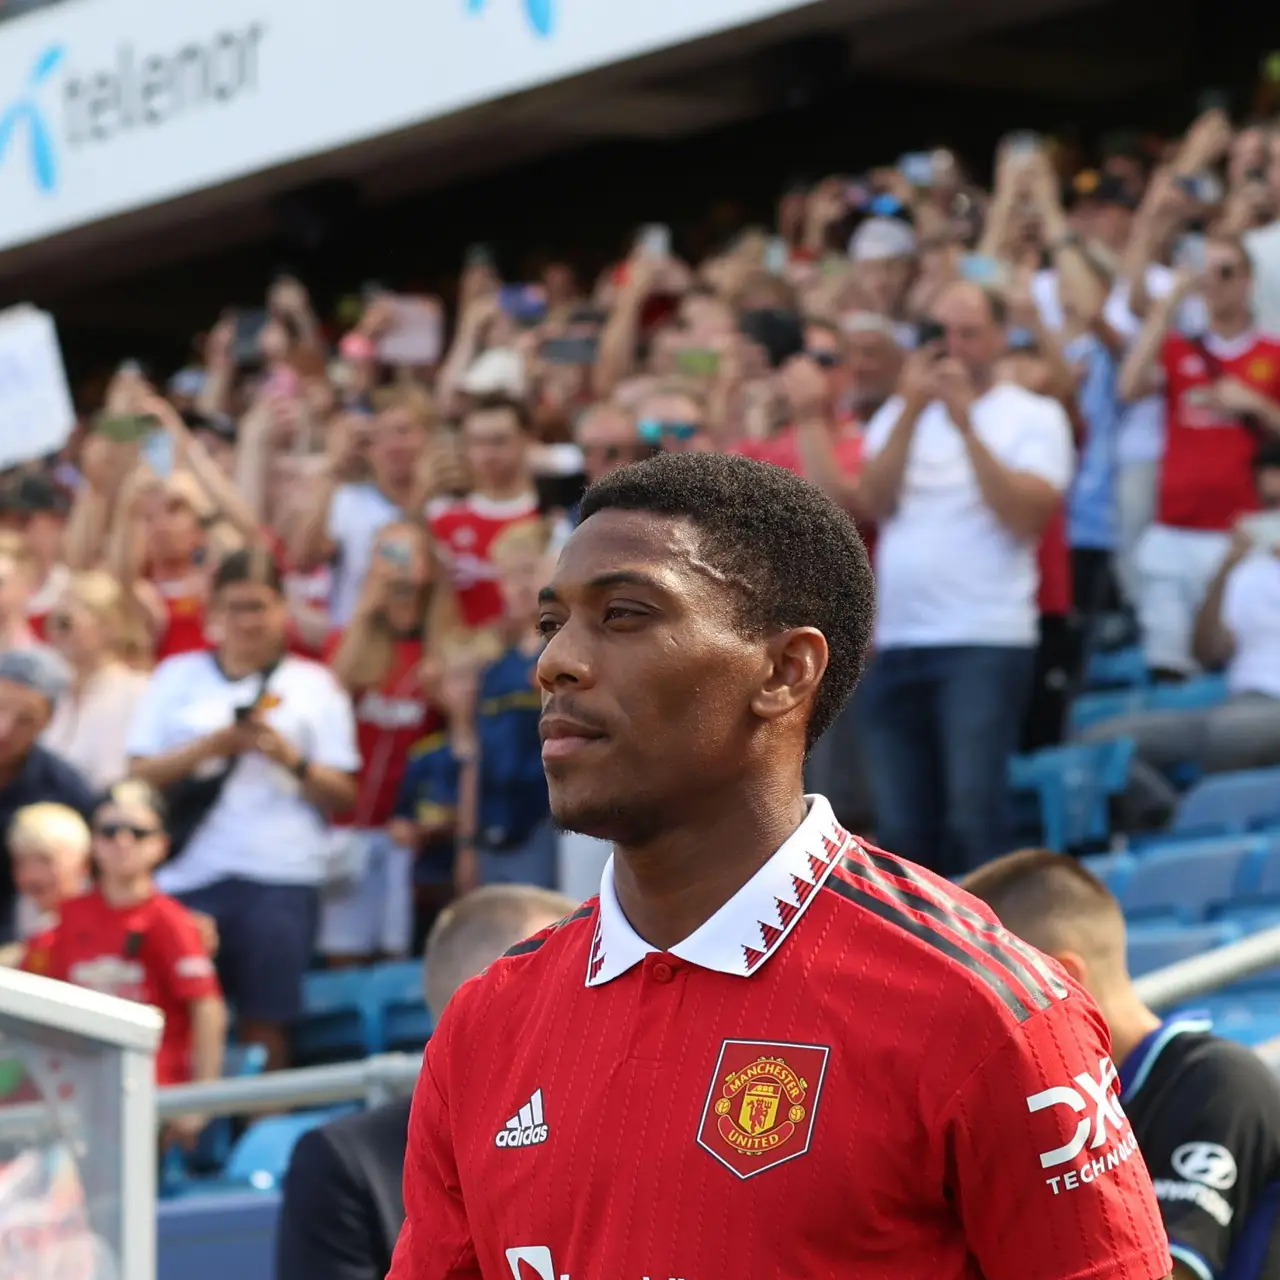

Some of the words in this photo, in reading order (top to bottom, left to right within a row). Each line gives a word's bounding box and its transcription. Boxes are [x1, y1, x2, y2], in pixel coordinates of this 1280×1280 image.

[62, 21, 267, 146] telenor
[729, 1063, 801, 1099] MANCHESTER
[494, 1122, 549, 1148] adidas
[728, 1129, 780, 1149] UNITED
